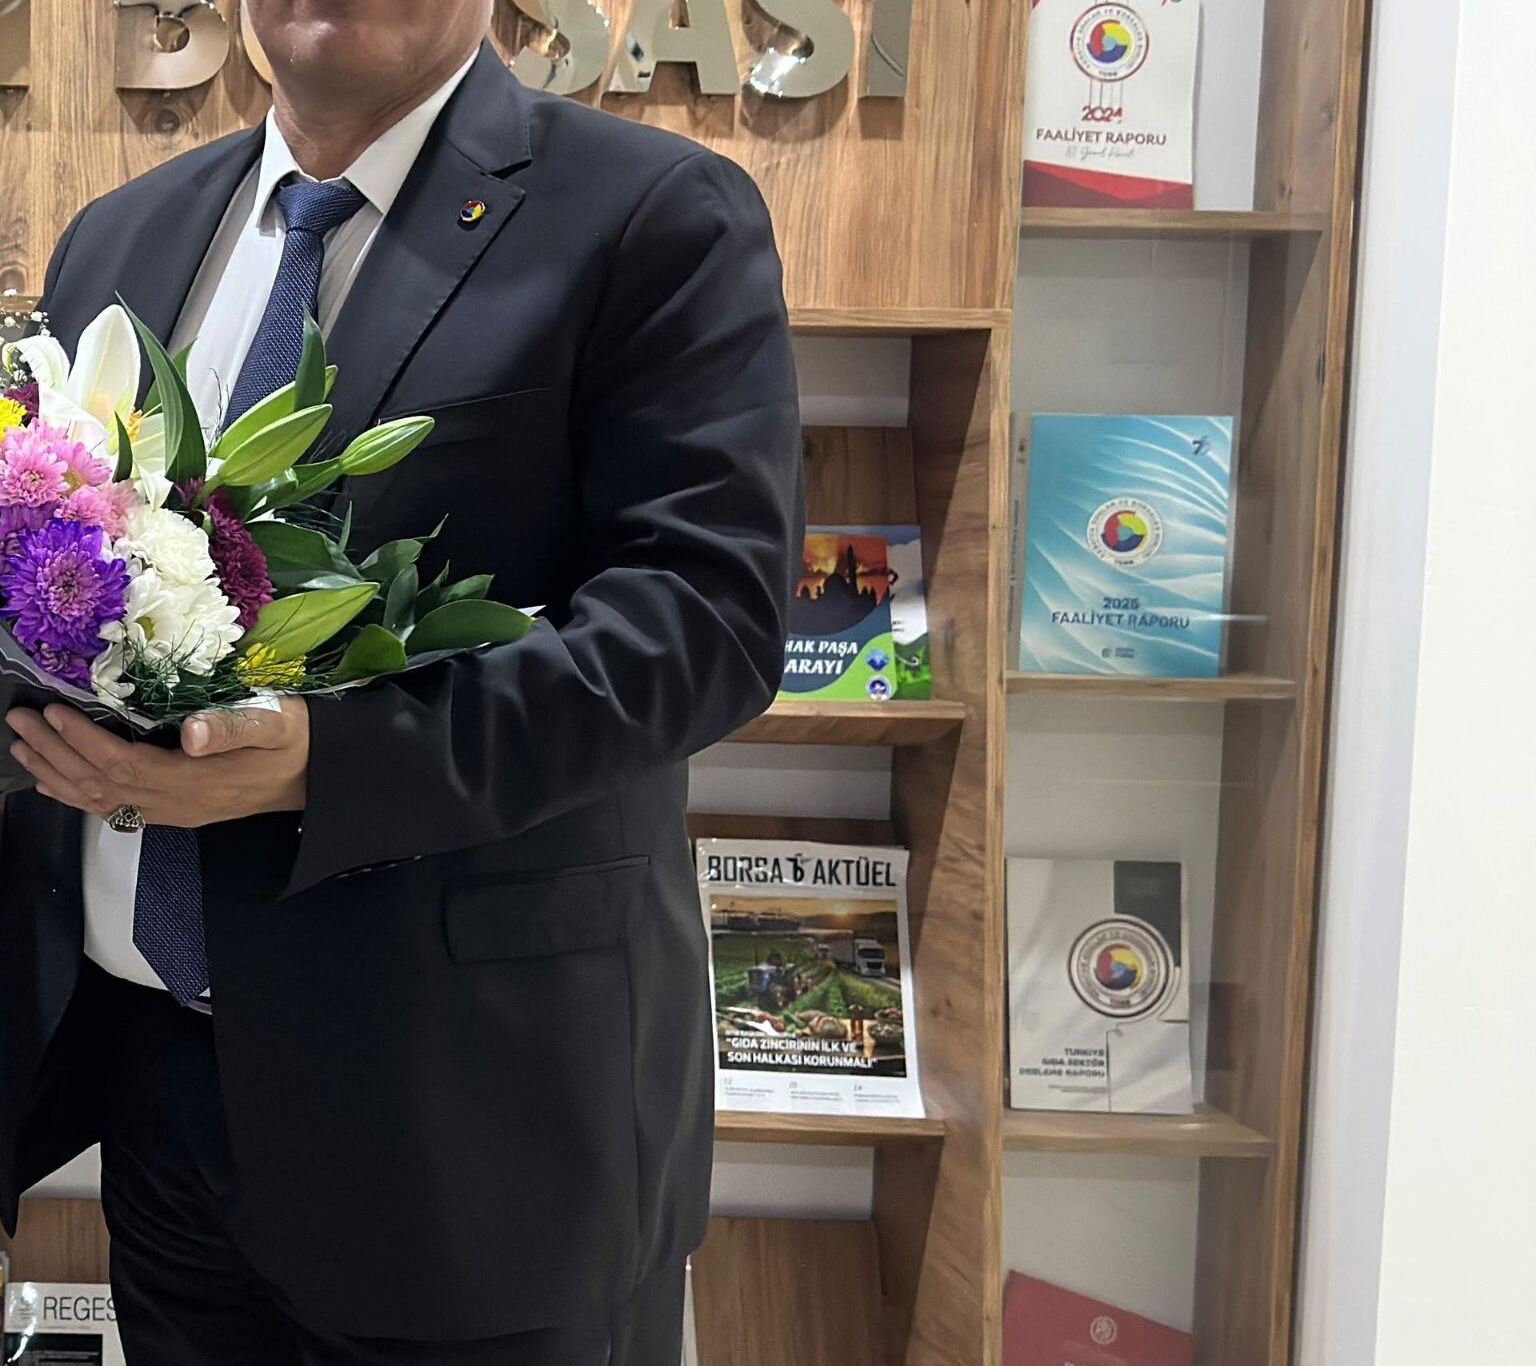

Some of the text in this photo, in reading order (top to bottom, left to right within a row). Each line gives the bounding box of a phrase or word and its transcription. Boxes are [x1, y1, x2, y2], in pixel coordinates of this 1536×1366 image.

[1081, 106, 1123, 124] 2024
[1036, 127, 1167, 146] FAALİYET RAPORU
[1103, 597, 1140, 610] 2025
[1051, 610, 1190, 629] FAALİYET RAPORU
[784, 639, 858, 657] HAK PAŞA
[784, 659, 843, 675] ARAYI
[707, 855, 783, 884] BORSA
[813, 856, 897, 887] AKTÜEL
[760, 1037, 820, 1051] ZİNCİRİNİN
[821, 1038, 840, 1052] İLK
[841, 1041, 858, 1053] VE
[727, 1052, 752, 1063] SON
[753, 1053, 802, 1065] HALKASI
[43, 1296, 117, 1322] REGES
